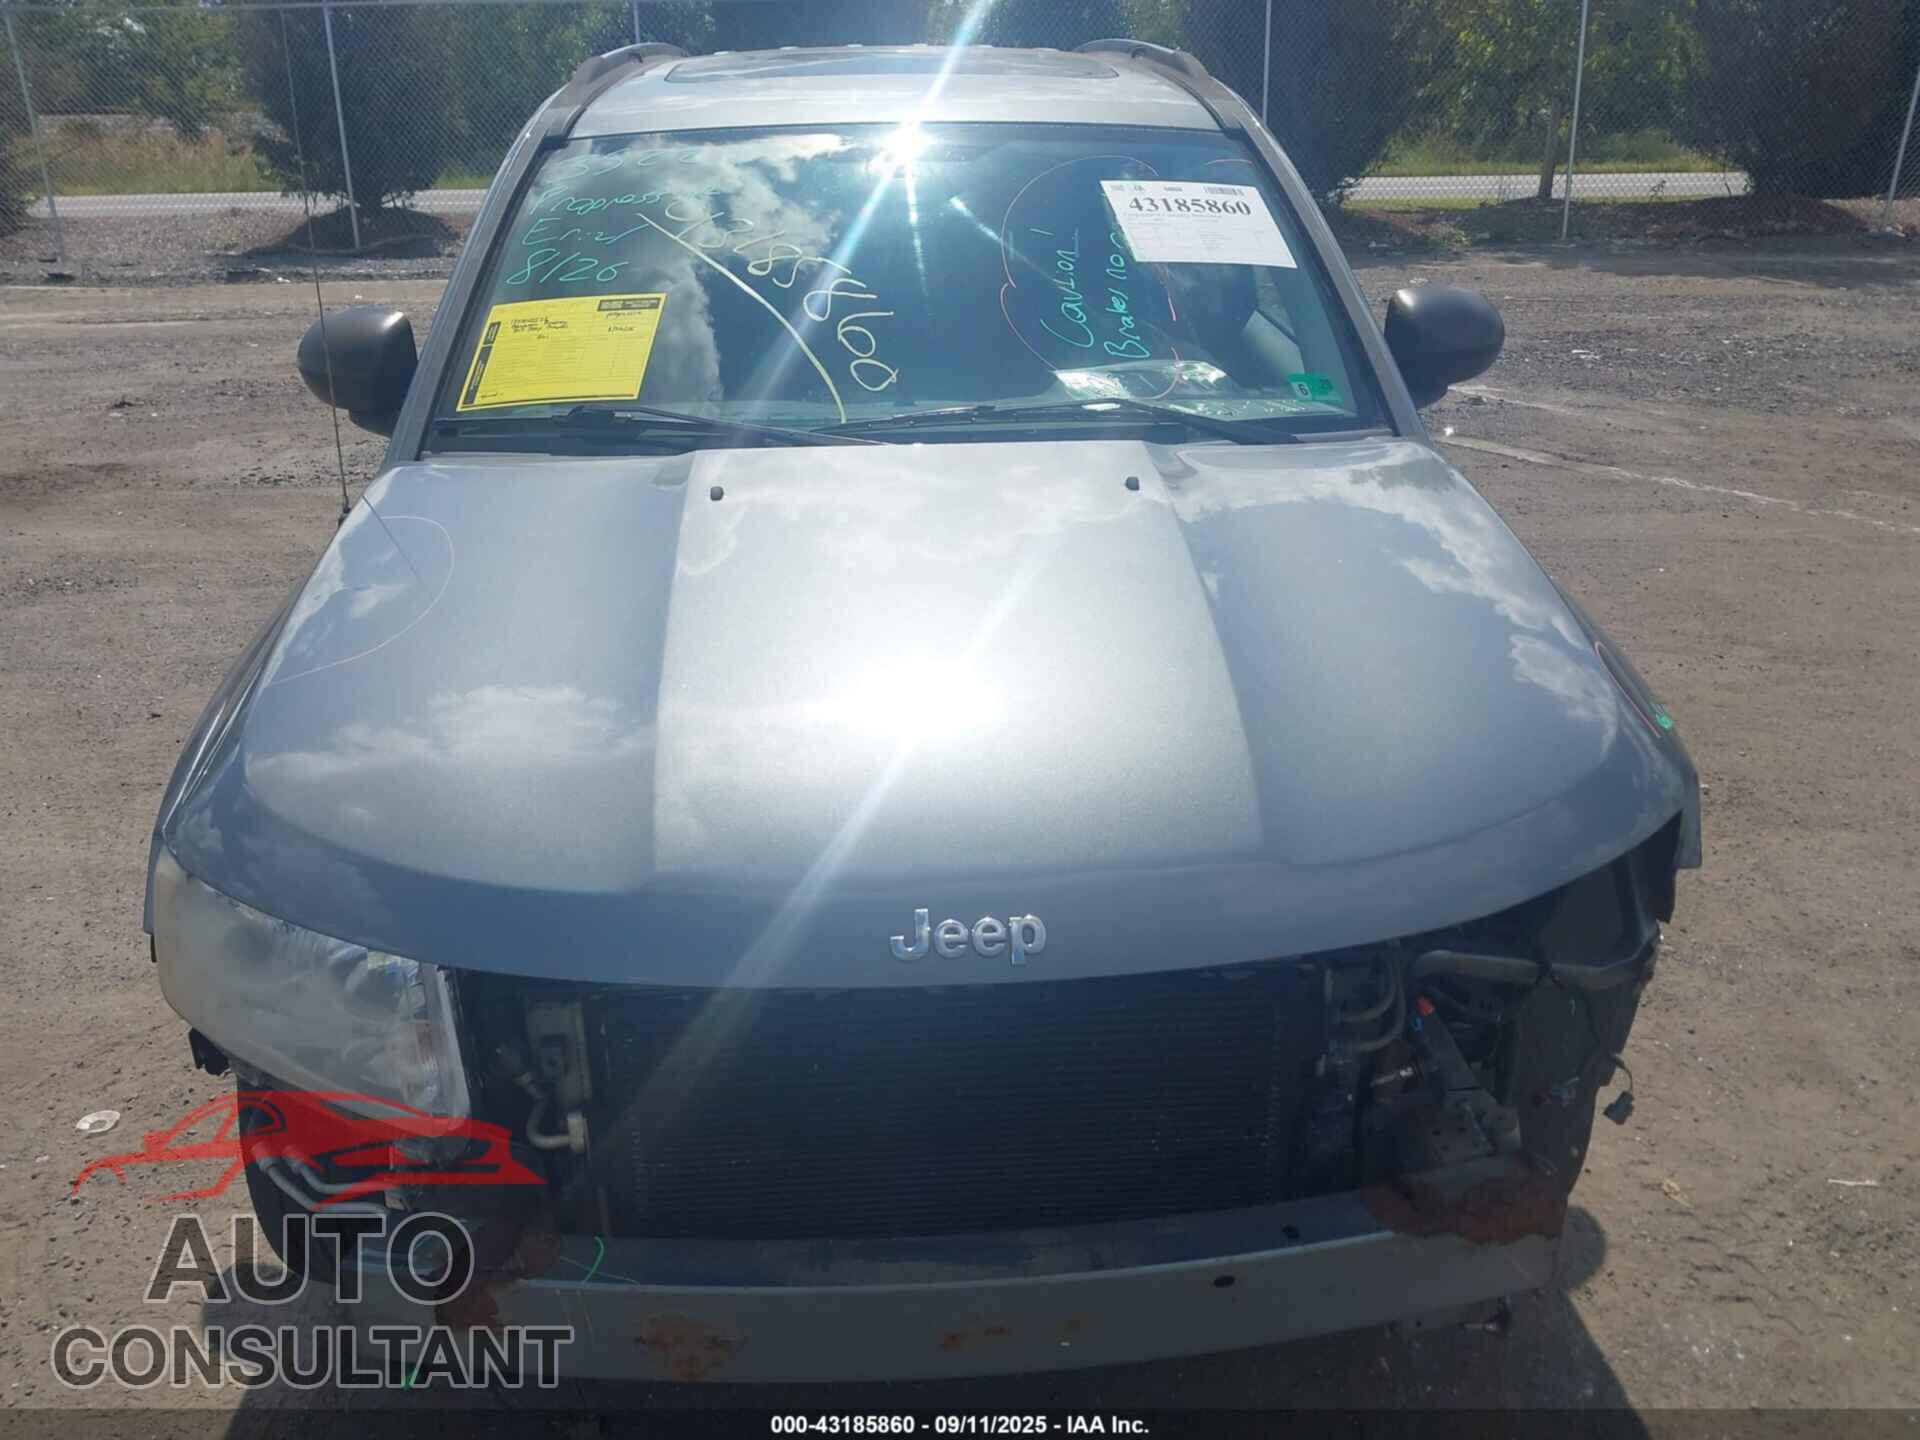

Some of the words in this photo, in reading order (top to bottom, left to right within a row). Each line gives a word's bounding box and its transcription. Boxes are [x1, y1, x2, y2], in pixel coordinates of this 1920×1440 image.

[1129, 197, 1251, 215] 43185860
[506, 248, 629, 285] 8/26
[890, 908, 1047, 965] Jeep
